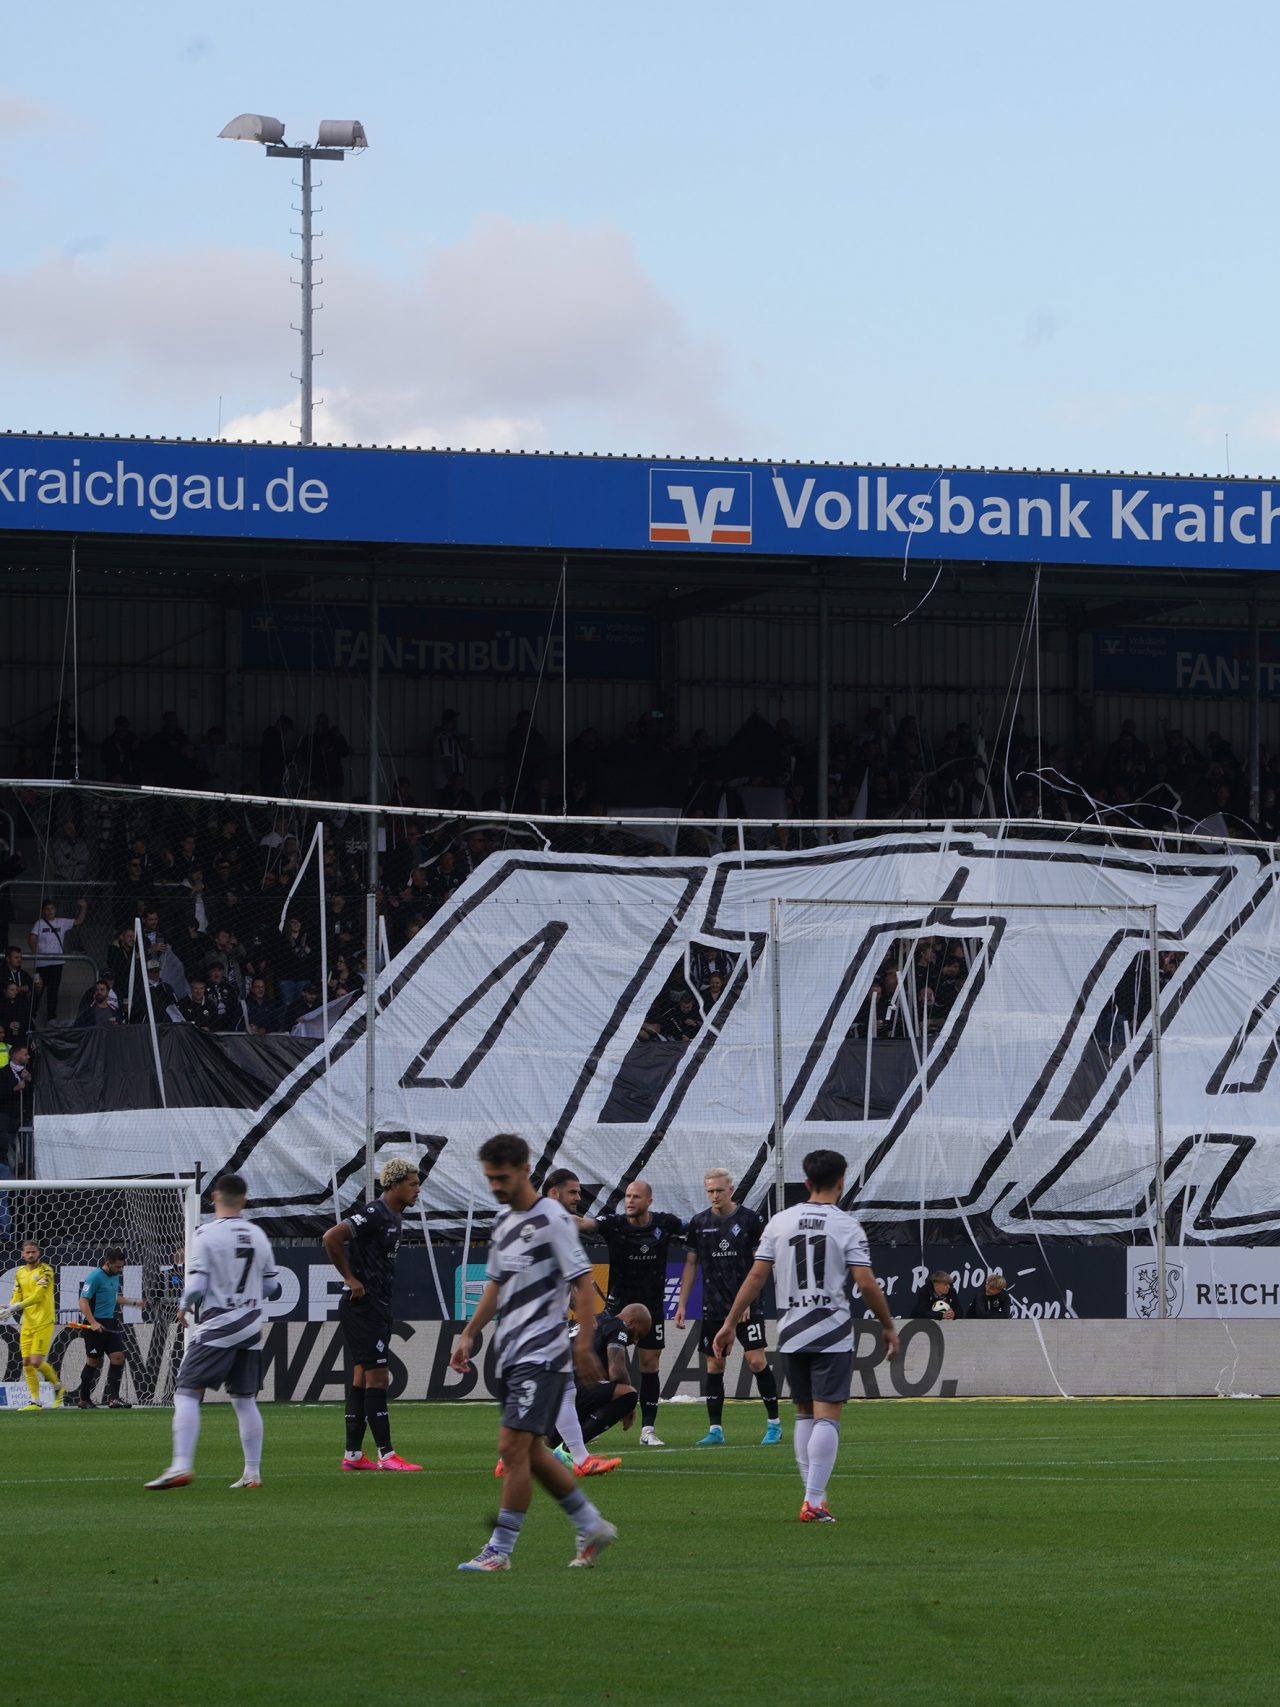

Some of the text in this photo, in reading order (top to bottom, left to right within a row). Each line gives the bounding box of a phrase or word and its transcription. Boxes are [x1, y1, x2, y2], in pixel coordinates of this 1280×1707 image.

[772, 475, 1091, 539] Volksbank
[334, 629, 566, 672] FAN-TRIBÜNE
[235, 1247, 255, 1294] 7
[711, 1250, 738, 1258] GALERIA
[788, 1234, 827, 1290] 11
[911, 1262, 1003, 1295] Rgion
[746, 1322, 762, 1343] 21
[517, 1379, 538, 1407] 3
